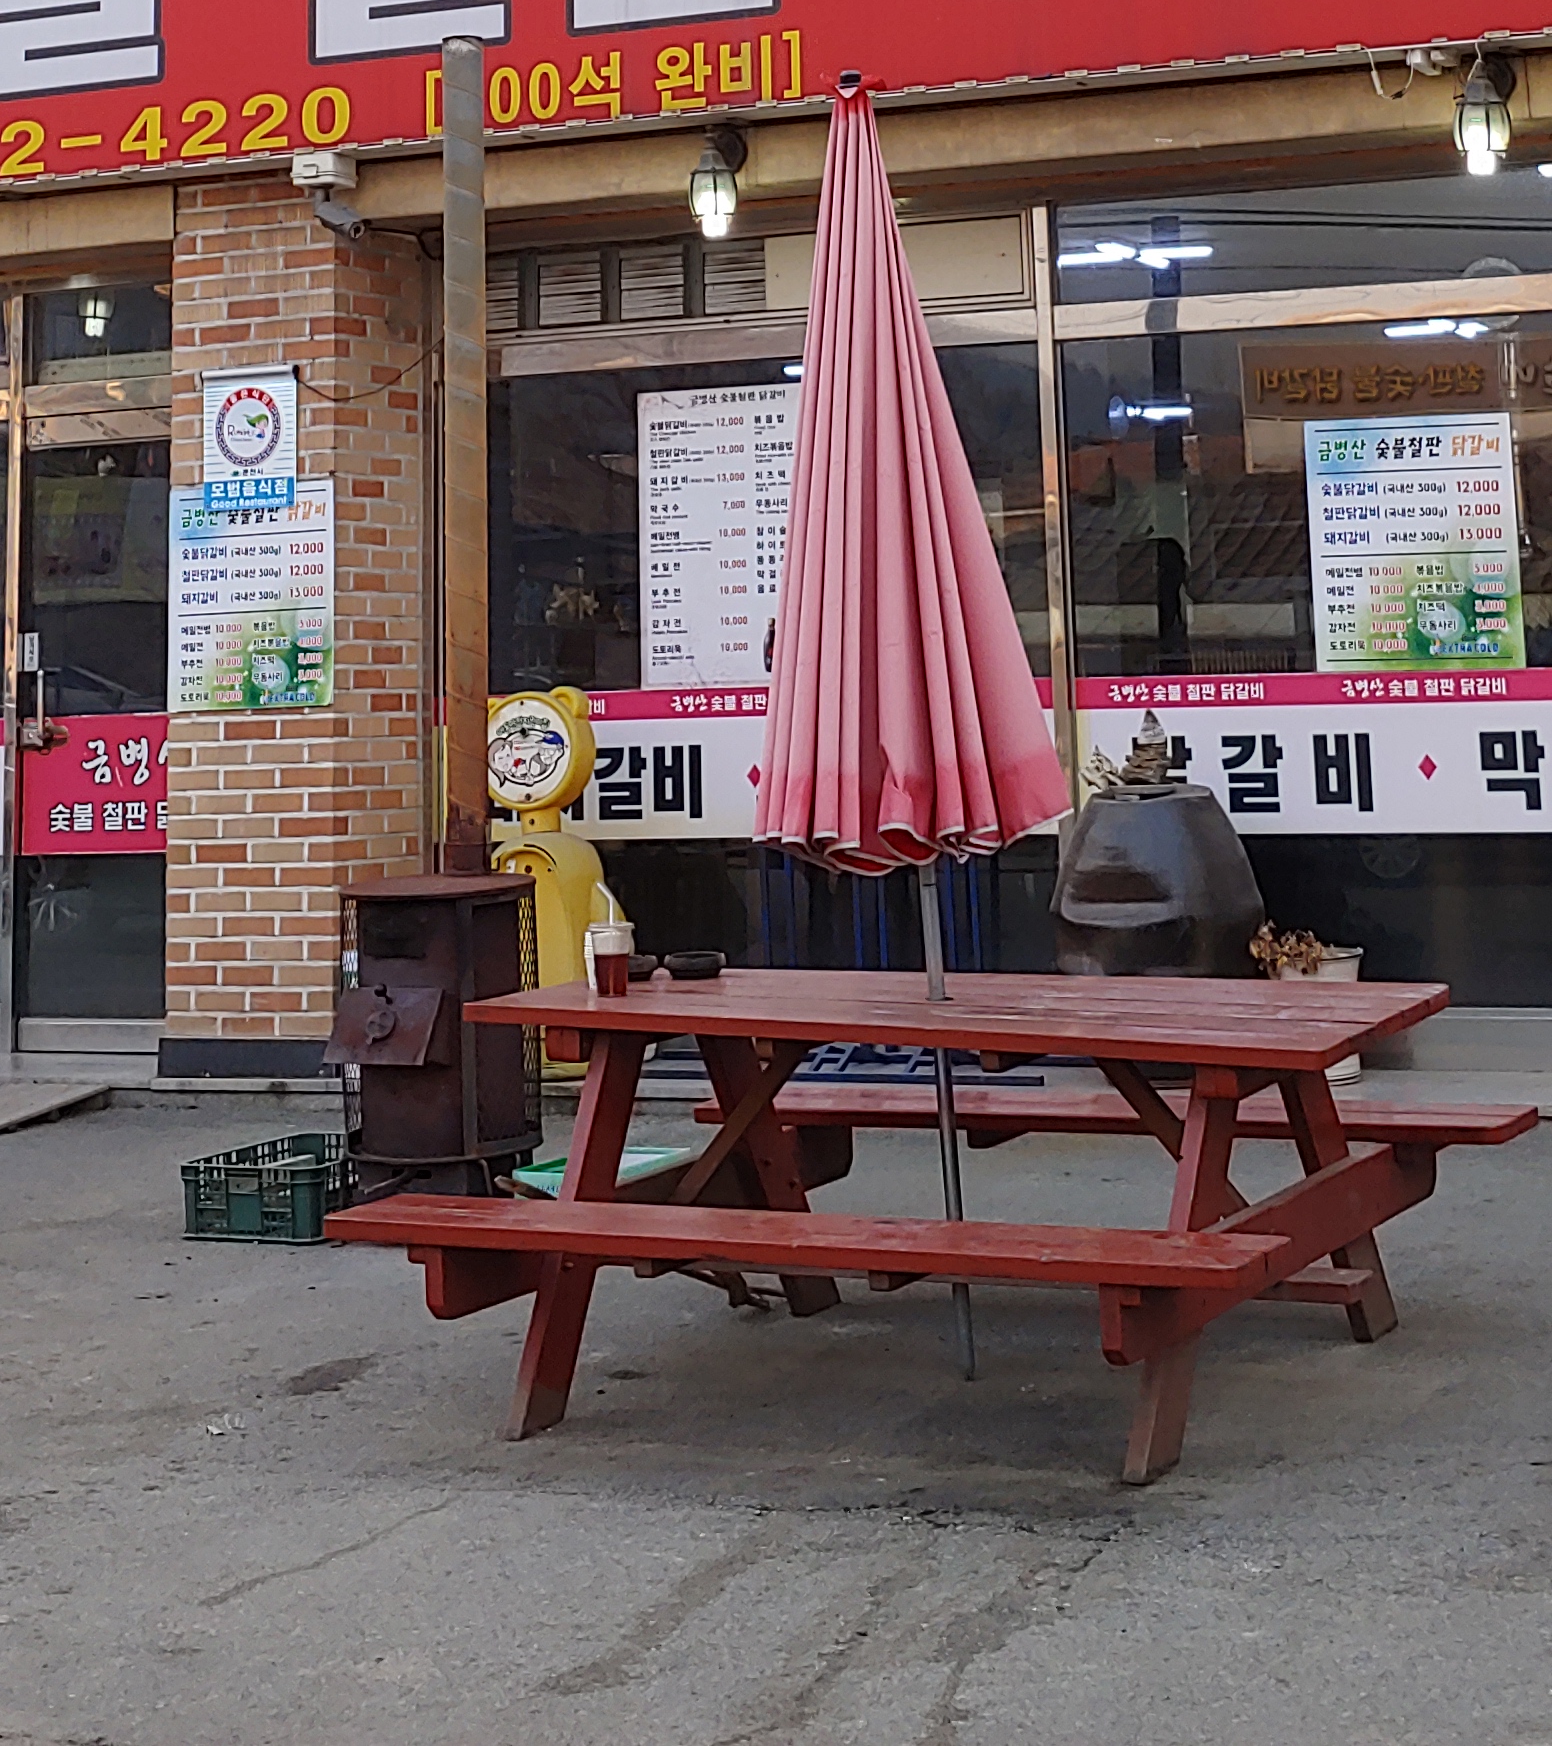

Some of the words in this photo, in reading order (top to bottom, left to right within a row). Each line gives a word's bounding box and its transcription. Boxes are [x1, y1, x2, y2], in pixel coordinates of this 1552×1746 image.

[426, 51, 625, 139] [00석
[654, 30, 803, 111] 완비]
[715, 416, 744, 428] 12,000
[716, 444, 744, 455] 12,000
[1317, 439, 1366, 462] 금병산
[1375, 435, 1443, 460] 숯불철판
[1451, 434, 1500, 457] 닭갈비
[716, 472, 745, 483] 13,000
[211, 477, 289, 498] 모범음식점
[1321, 481, 1378, 497] 숯불닭갈비
[1383, 482, 1414, 495] (국내산
[1456, 479, 1499, 494] 12,000
[211, 499, 237, 510] Good
[239, 495, 287, 507] Restaurant
[1322, 505, 1380, 521] 철판닭갈비
[1384, 507, 1415, 519] (국내산
[1458, 504, 1501, 518] 12,000
[718, 528, 746, 538] 10,000
[1323, 530, 1371, 546] 돼지갈비
[1385, 531, 1417, 544] (국내산
[289, 542, 324, 555] 12,000
[289, 563, 324, 576] 12,000
[719, 559, 747, 569] 10,000
[181, 590, 219, 604] 돼지갈비
[720, 616, 748, 626] 10,000
[1107, 682, 1150, 703] 금병산
[1152, 683, 1181, 702] 숯불
[1186, 681, 1217, 701] 철판
[1220, 680, 1265, 701] 닭갈비
[1341, 677, 1386, 698] 금병산
[1388, 678, 1419, 697] 숯불
[1423, 676, 1455, 696] 철판
[1459, 674, 1507, 696] 닭갈비
[670, 694, 708, 713] 금병산
[710, 694, 737, 711] 숯불
[50, 803, 93, 832] 숯불
[102, 801, 148, 831] 철판
